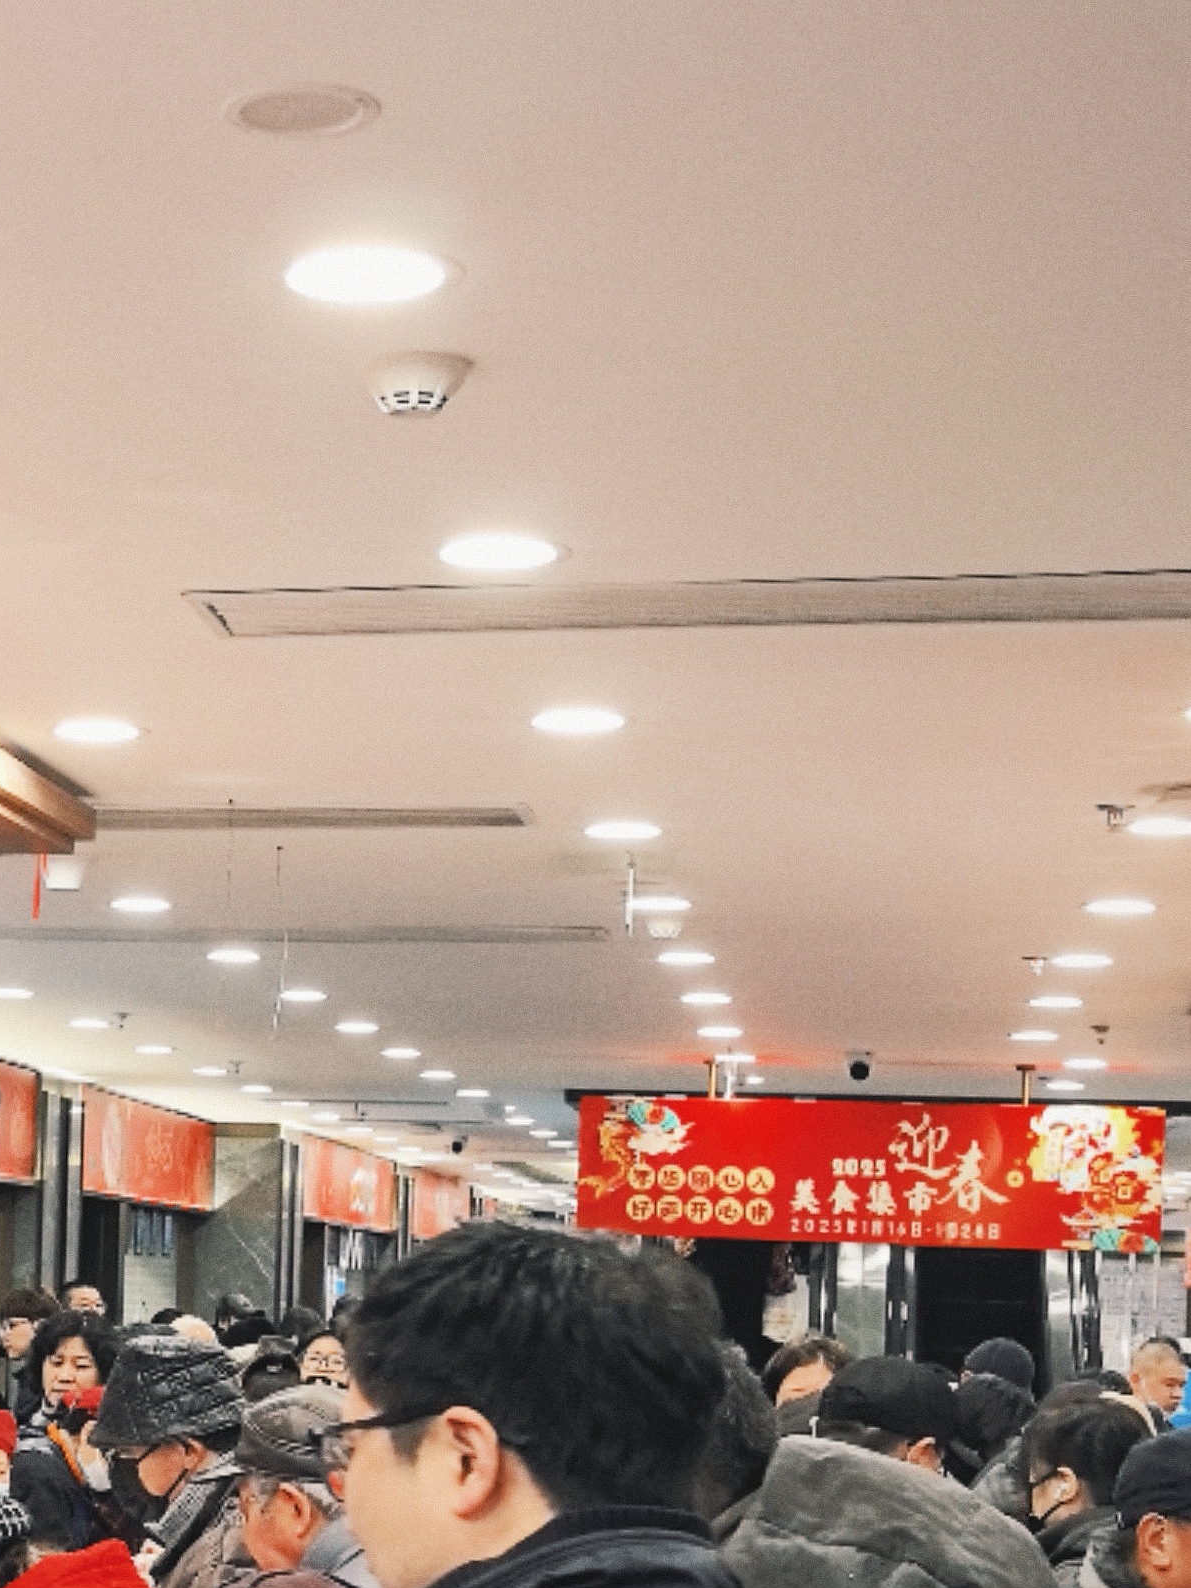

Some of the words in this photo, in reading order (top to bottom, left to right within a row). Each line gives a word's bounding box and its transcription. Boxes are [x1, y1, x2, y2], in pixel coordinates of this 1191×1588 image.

[831, 1158, 887, 1177] 2025
[888, 1112, 1009, 1214] 迎春
[789, 1177, 939, 1217] 美食集市
